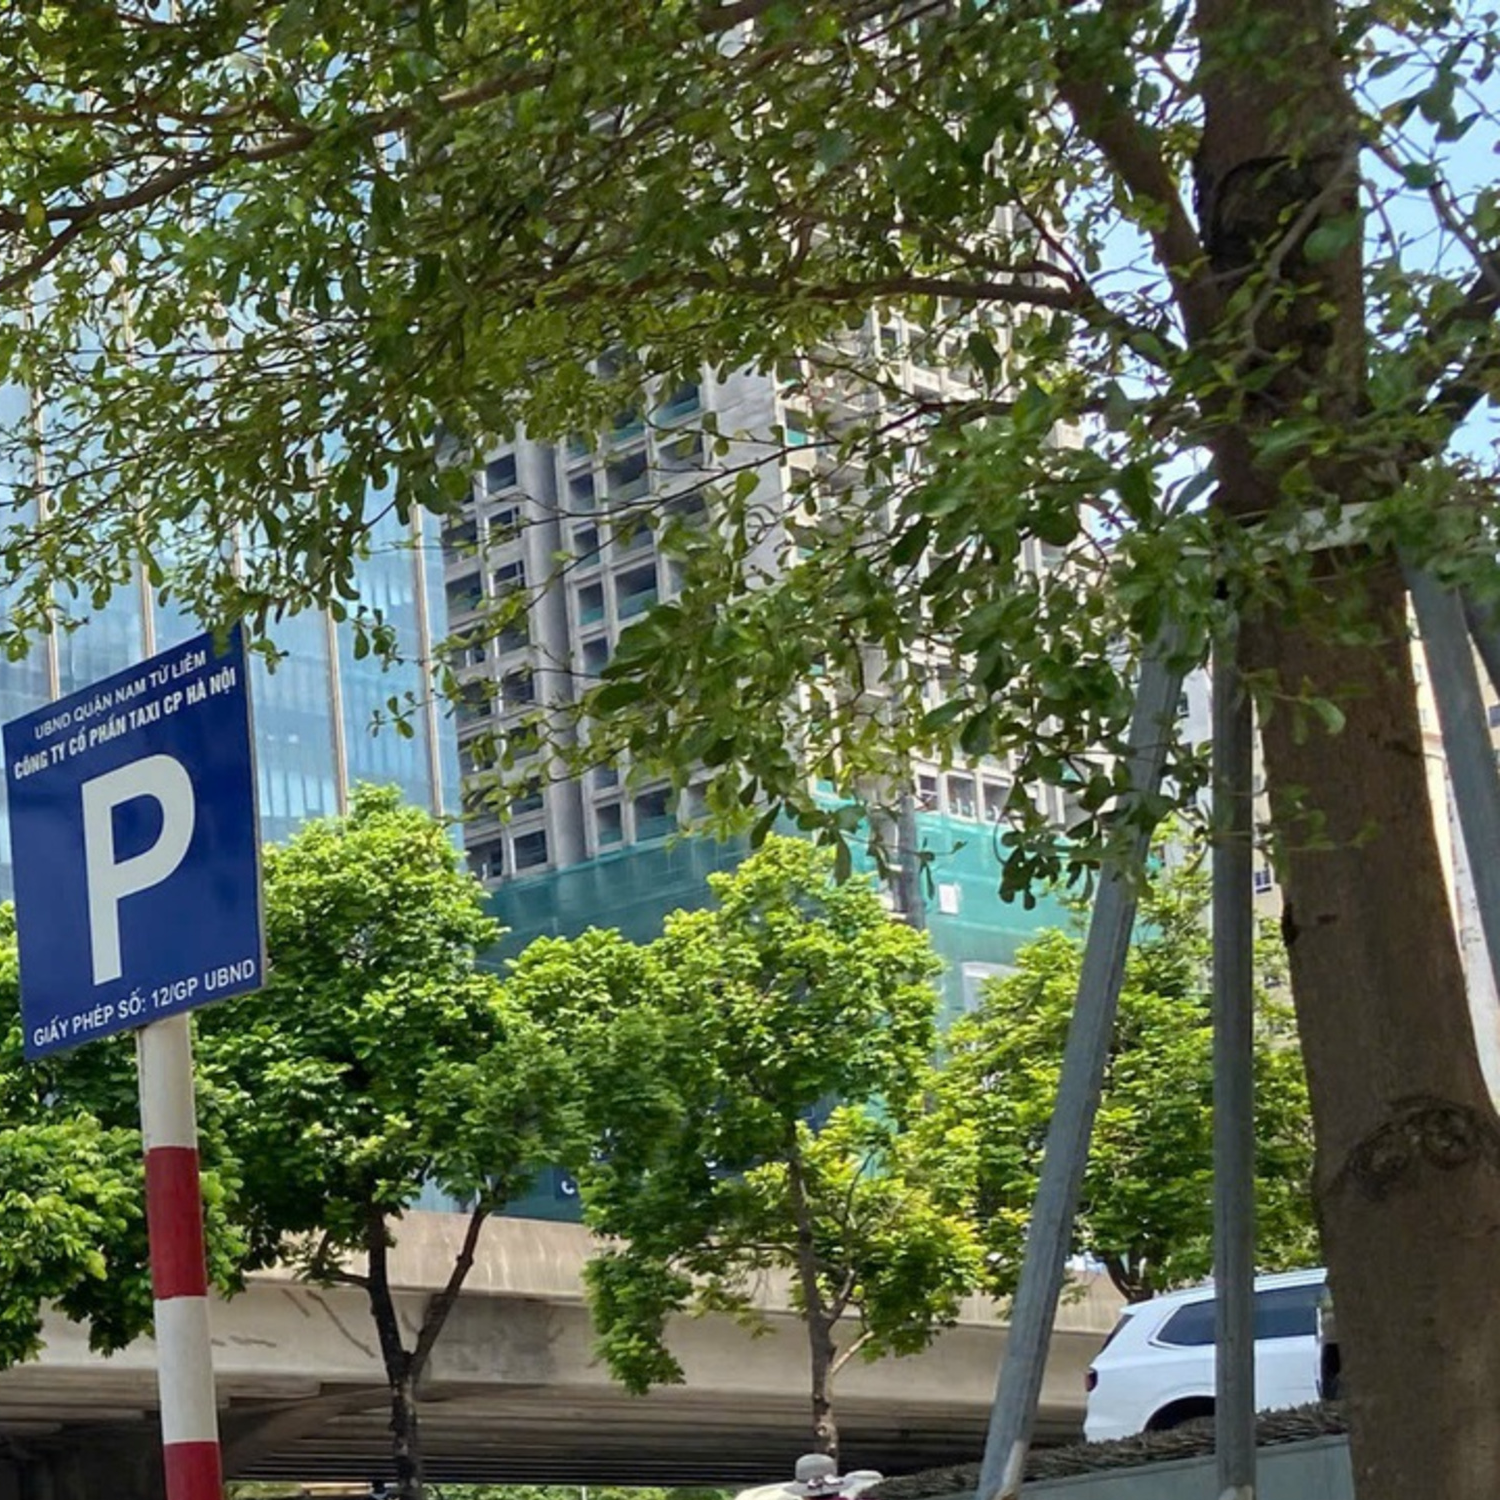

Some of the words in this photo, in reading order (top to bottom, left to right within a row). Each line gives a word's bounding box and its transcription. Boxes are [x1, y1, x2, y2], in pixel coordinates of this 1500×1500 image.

[13, 754, 48, 780] CÔNG
[50, 742, 66, 765] TY
[129, 701, 160, 730] TAXI
[163, 691, 183, 715] CP
[186, 677, 206, 706] HÀ
[209, 666, 236, 695] NỘI
[34, 712, 71, 740] UBND
[73, 693, 112, 722] QUẬN
[115, 678, 147, 704] NAM
[171, 650, 206, 679] LIÊM
[80, 753, 196, 986] P
[33, 1014, 69, 1047] GIẤY
[72, 1002, 115, 1035] PHÉP
[118, 986, 147, 1019] SỐ:
[151, 976, 199, 1009] 12/GP
[204, 958, 256, 991] UBND
